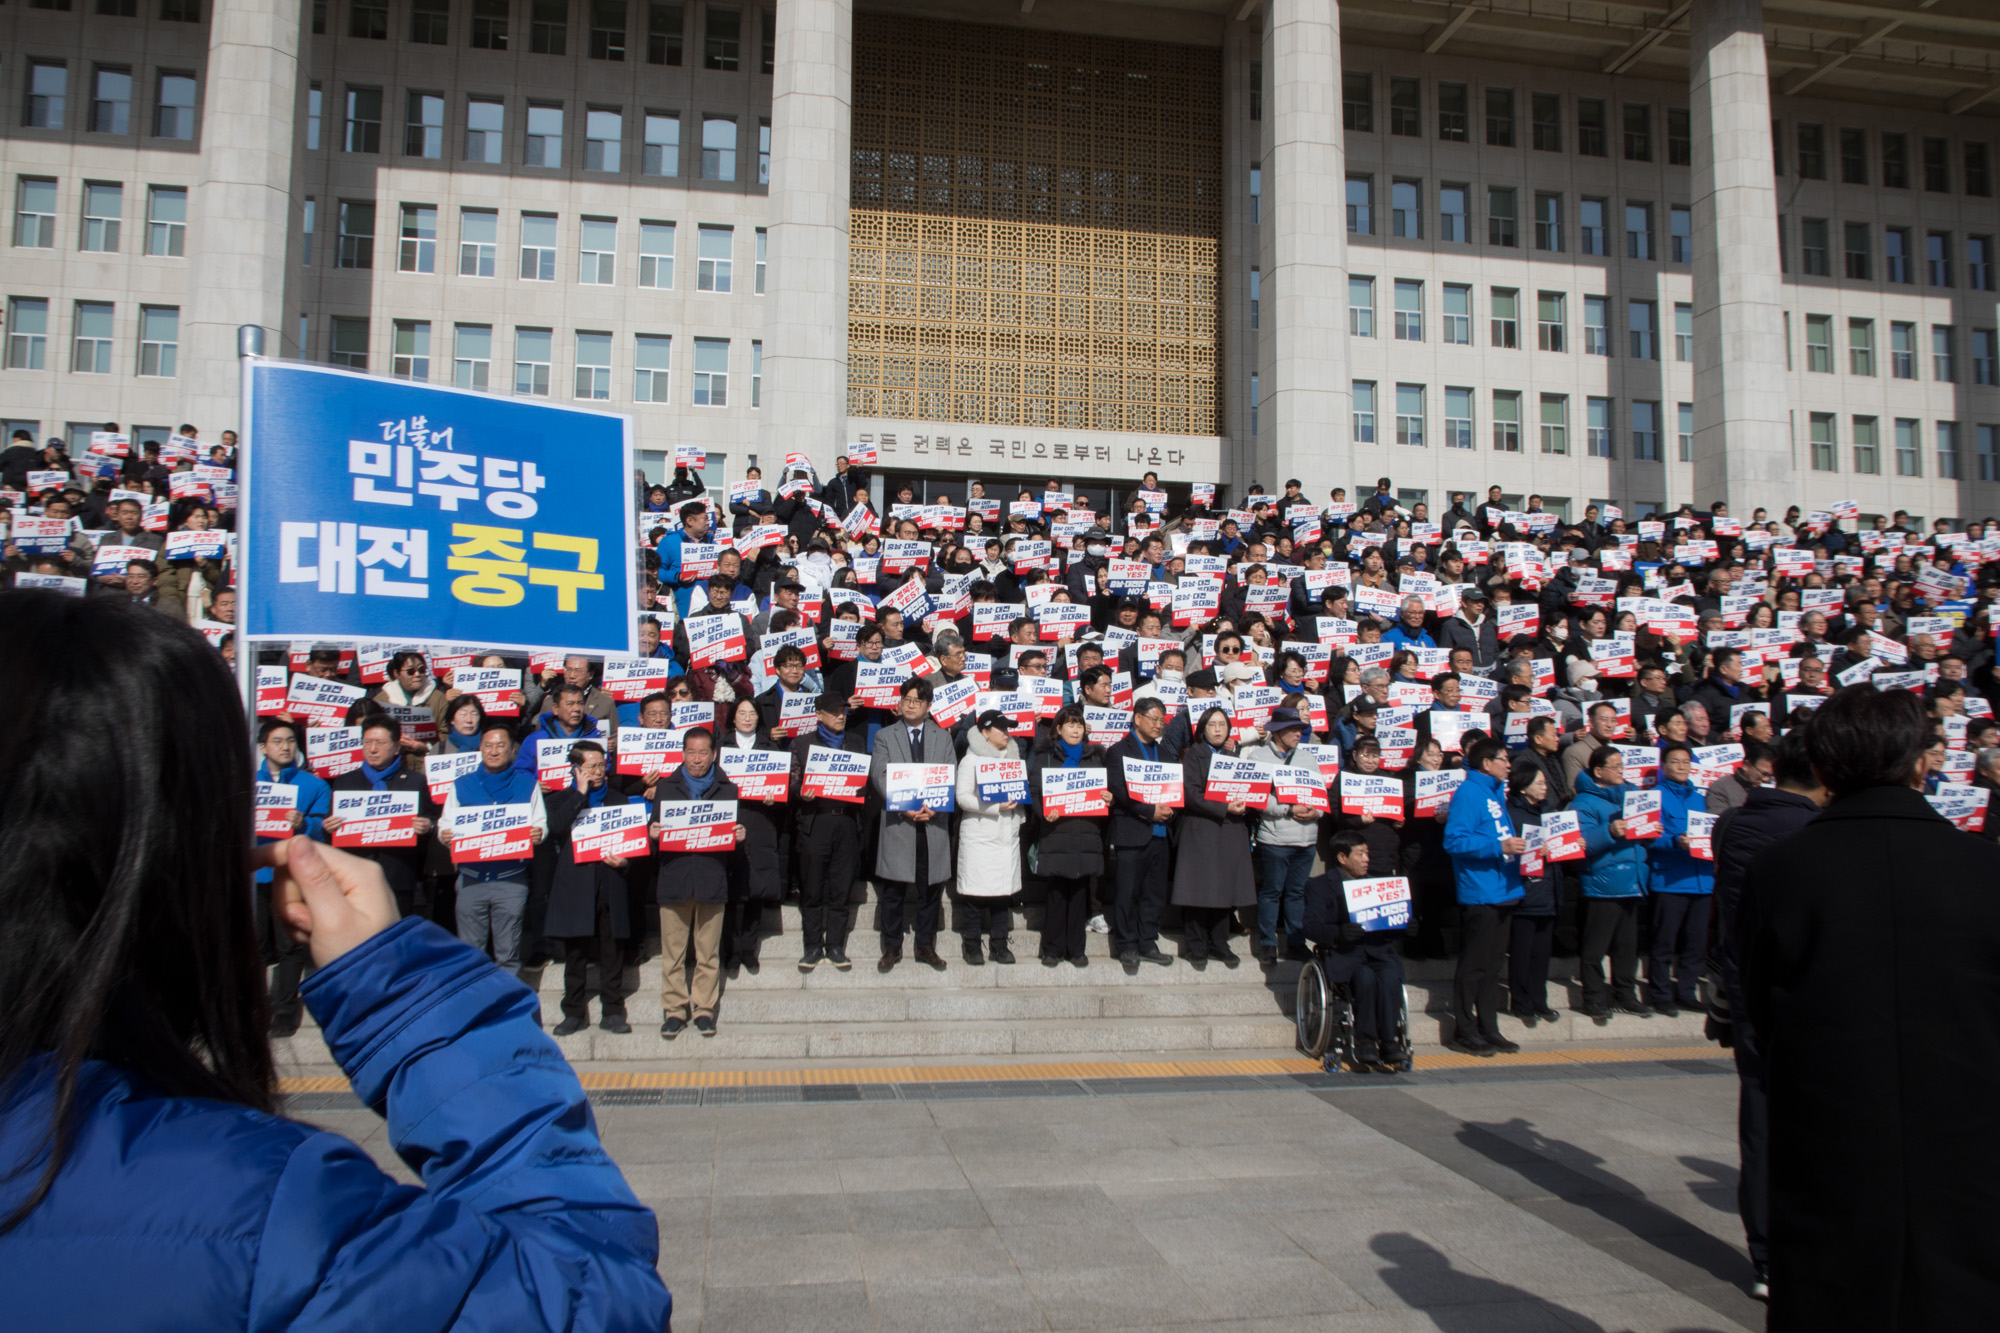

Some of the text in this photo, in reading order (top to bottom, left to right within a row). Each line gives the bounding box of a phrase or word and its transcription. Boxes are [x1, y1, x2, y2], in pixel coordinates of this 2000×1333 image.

[379, 416, 454, 451] 더불어
[914, 435, 973, 456] 권력은
[990, 440, 1110, 463] 국민으로부터
[1127, 447, 1186, 466] 나온다
[349, 440, 545, 519] 민주당
[280, 521, 604, 612] 대전 중구
[899, 586, 921, 606] YES?
[912, 603, 931, 621] NO?
[458, 671, 500, 682] 충남·대전
[860, 667, 896, 676] 충남·대전
[1238, 689, 1269, 700] 충남·대전
[1086, 711, 1127, 720] 충남·대전
[622, 730, 667, 742] 충남·대전
[724, 753, 769, 764] 충남·대전
[810, 753, 851, 763] 충남·대전
[980, 761, 1021, 773] 대구·경북은
[1127, 764, 1162, 772] 충남·대전
[1214, 761, 1255, 770] 충남·대전
[1000, 771, 1022, 780] YES?
[1045, 768, 1087, 783] 충남·대전
[1276, 769, 1310, 778] 충남·대전
[338, 794, 392, 809] 충남·대전
[1007, 791, 1027, 801] NO?
[924, 797, 949, 808] NO?
[665, 803, 714, 817] 충남·대전
[455, 808, 506, 825] 충남·대전
[689, 812, 733, 825] 홀대하는
